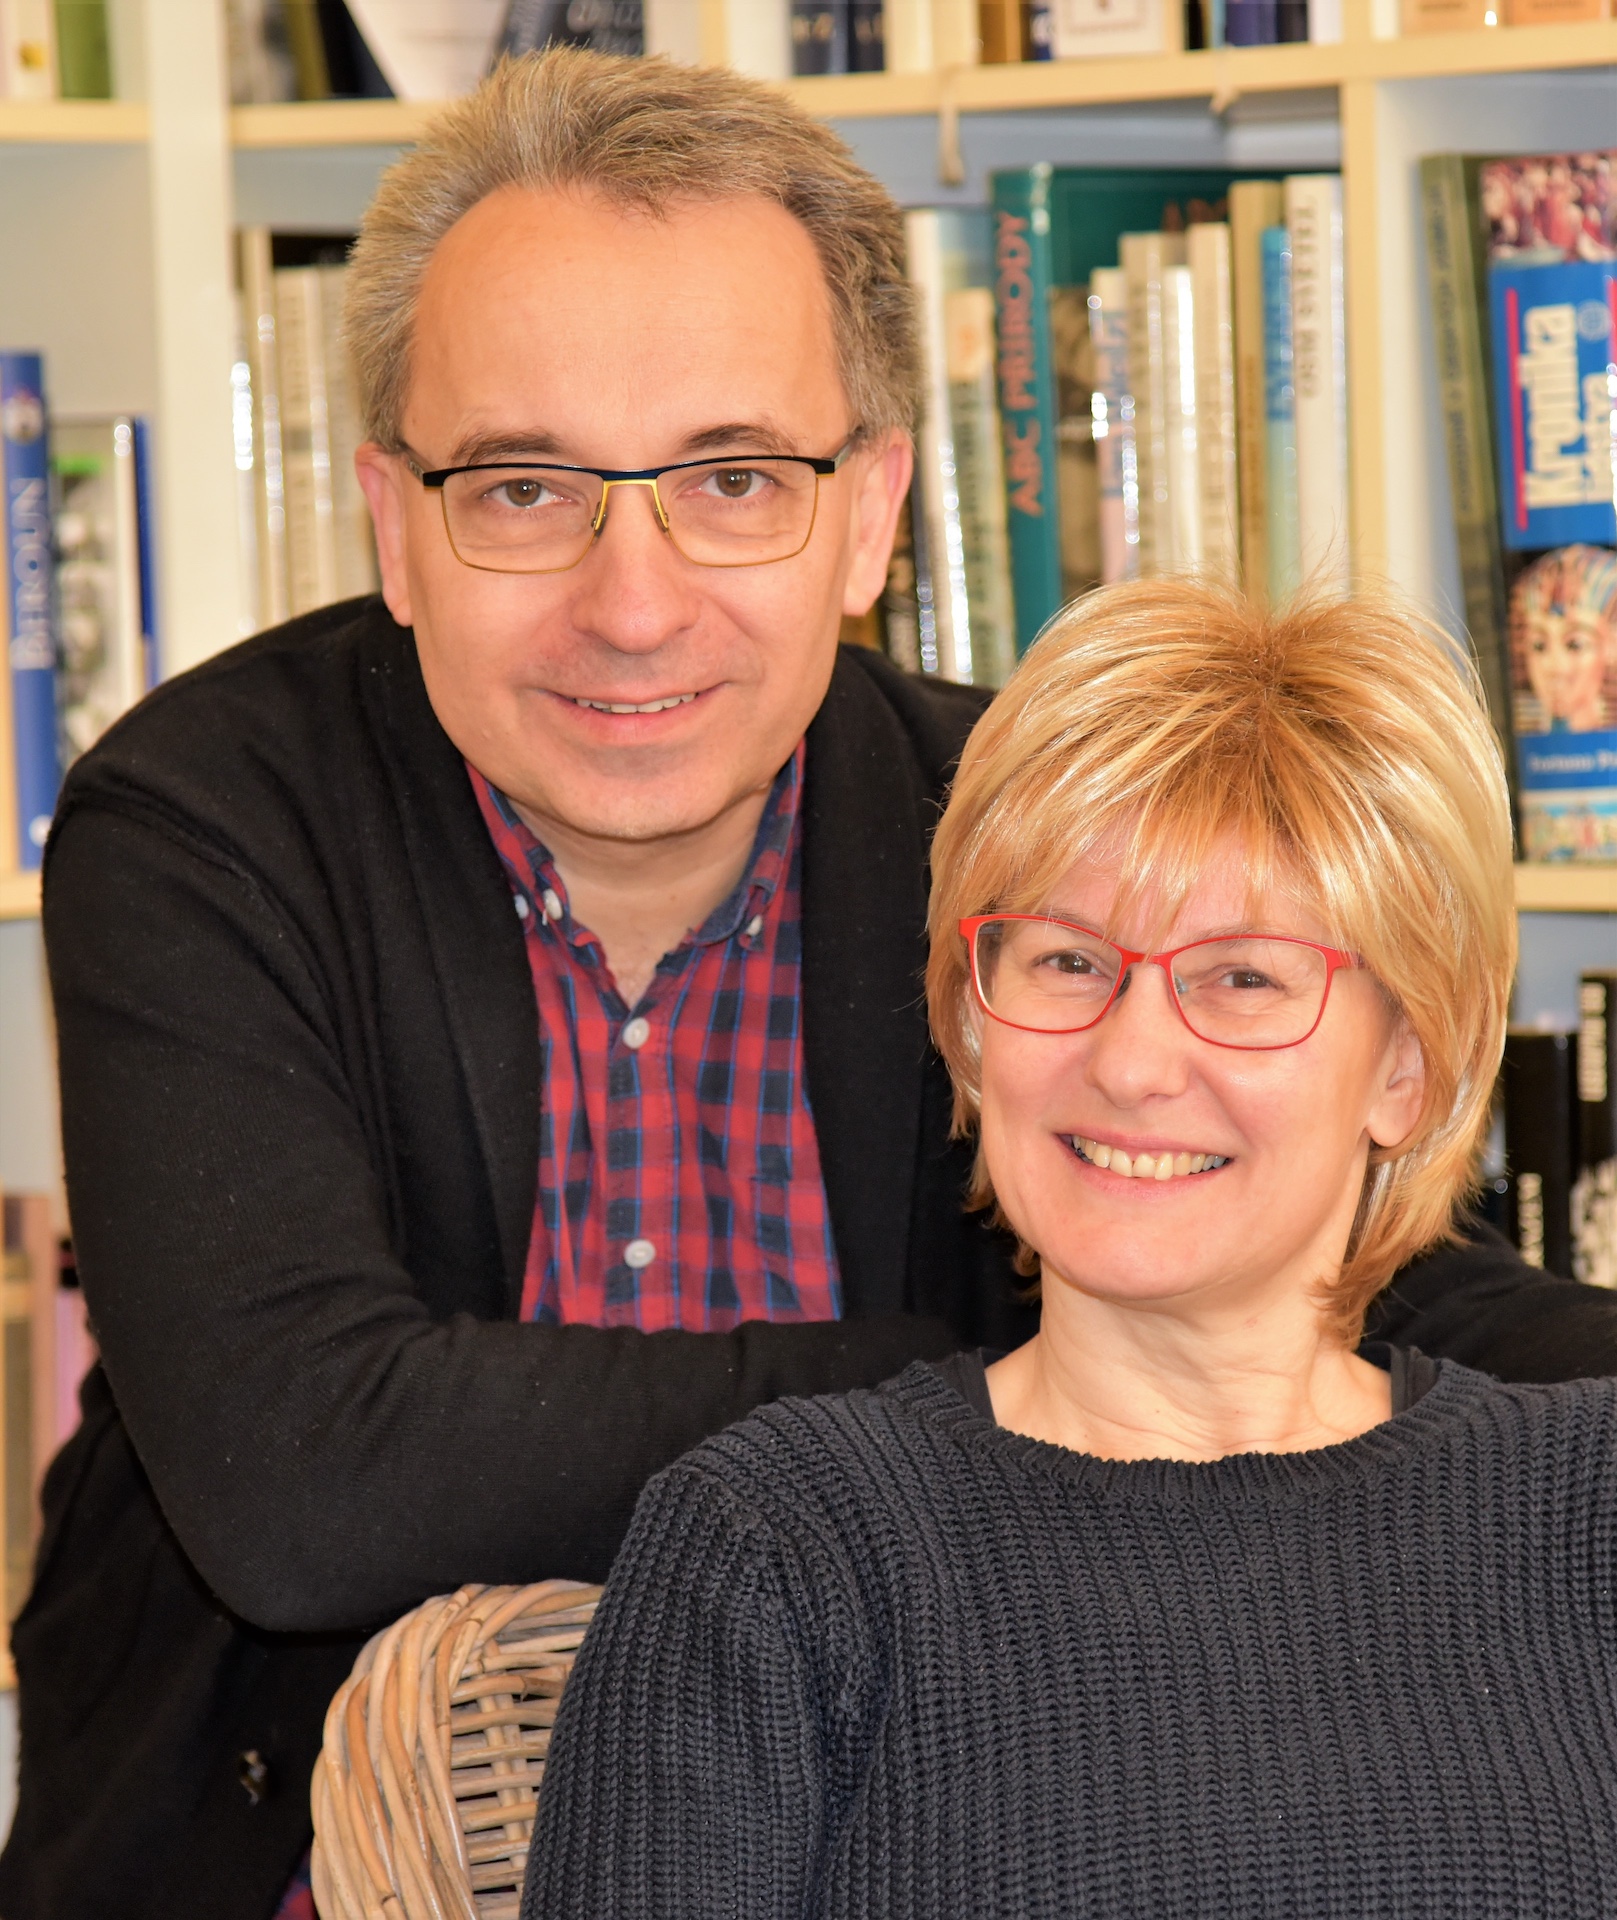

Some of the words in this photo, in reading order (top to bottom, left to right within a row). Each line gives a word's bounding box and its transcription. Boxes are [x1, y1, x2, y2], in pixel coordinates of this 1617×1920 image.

[1004, 418, 1044, 517] ABC
[1518, 304, 1582, 509] Kronika
[10, 478, 55, 670] BEROUN
